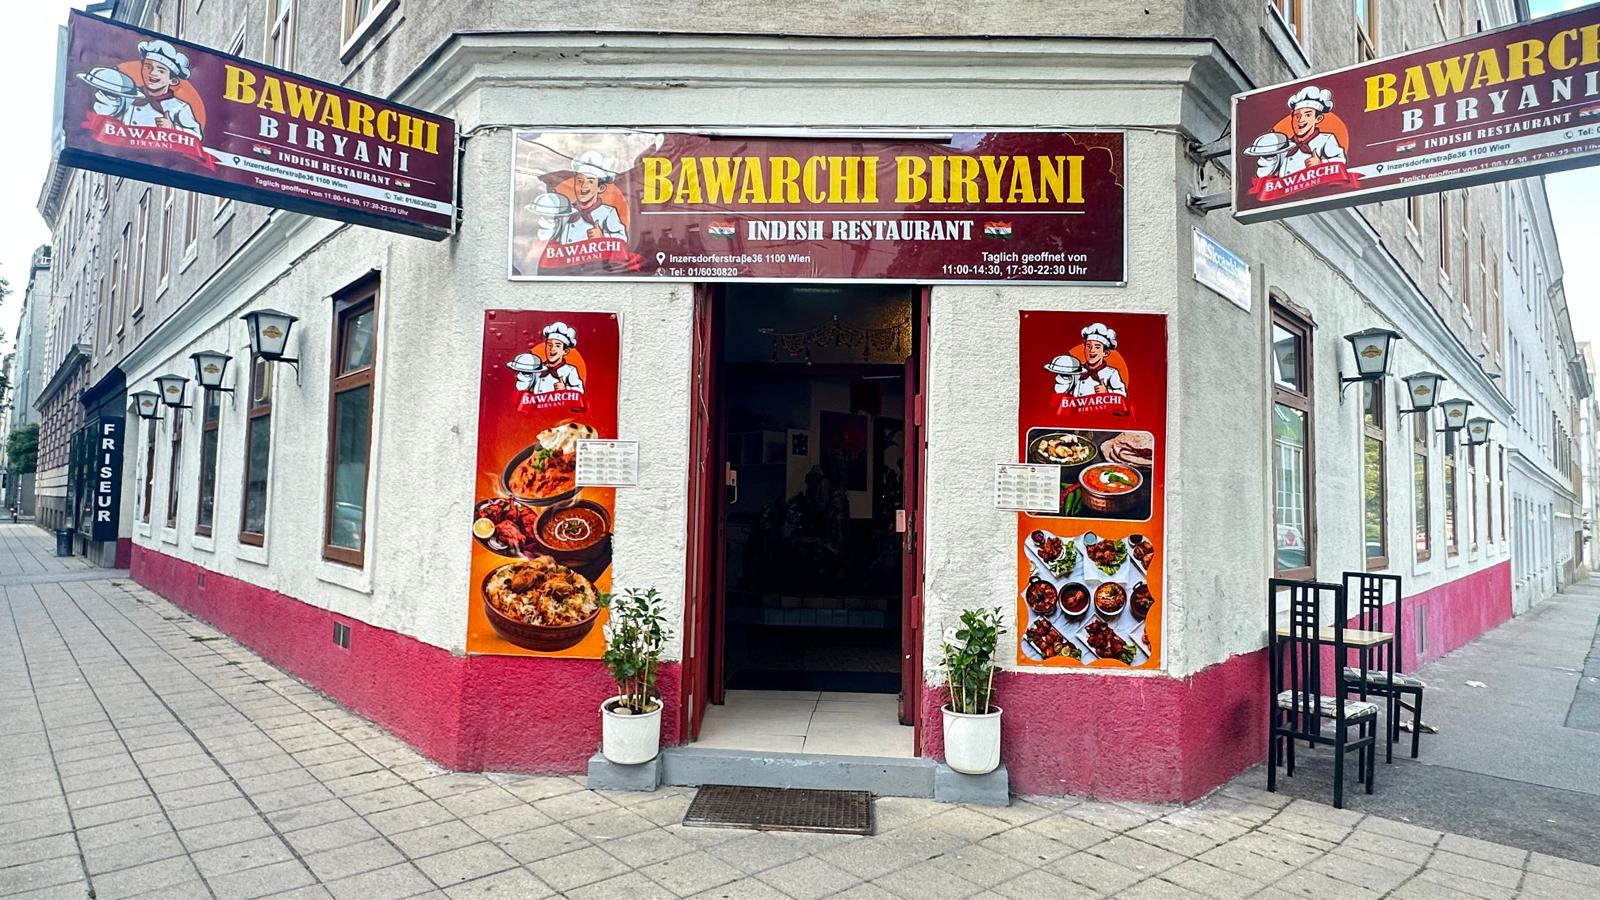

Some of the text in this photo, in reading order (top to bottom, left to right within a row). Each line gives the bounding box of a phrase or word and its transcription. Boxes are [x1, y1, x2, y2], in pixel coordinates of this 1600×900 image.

[1401, 70, 1599, 133] BIRYANI
[223, 64, 440, 155] BAWARCHI
[104, 123, 195, 147] BAWARCHI
[1424, 130, 1472, 149] INDISH
[1477, 112, 1572, 139] RESTAURANT
[130, 139, 173, 149] BIRYANI
[259, 115, 409, 172] BIRYANI
[1469, 146, 1487, 156] 1100
[1488, 143, 1511, 153] Wien
[278, 151, 391, 186] INDISH RESTAURANT
[315, 176, 331, 186] 1100
[331, 179, 348, 189] Wien
[641, 155, 1085, 205] BAWARCHI BIRYANI
[1265, 164, 1340, 192] BAWARCHI
[1284, 178, 1320, 193] BIRYANI
[397, 207, 409, 216] Uhr
[747, 220, 974, 241] INDISH RESTAURANT
[546, 241, 621, 258] BAWARCHI
[566, 253, 602, 264] BIRYANI
[669, 254, 811, 264] Inzersdorferstraße36 1100 Wien
[981, 251, 1087, 264] Taglich geoffnet von
[669, 267, 738, 276] Tel: 01/6030820
[942, 265, 1088, 276] 11:00-14:30, 17:30-22:30 Uhr
[522, 392, 579, 405] BAWARCHI
[1061, 395, 1122, 408] BAWARCHI
[97, 423, 115, 522] FRISEUR
